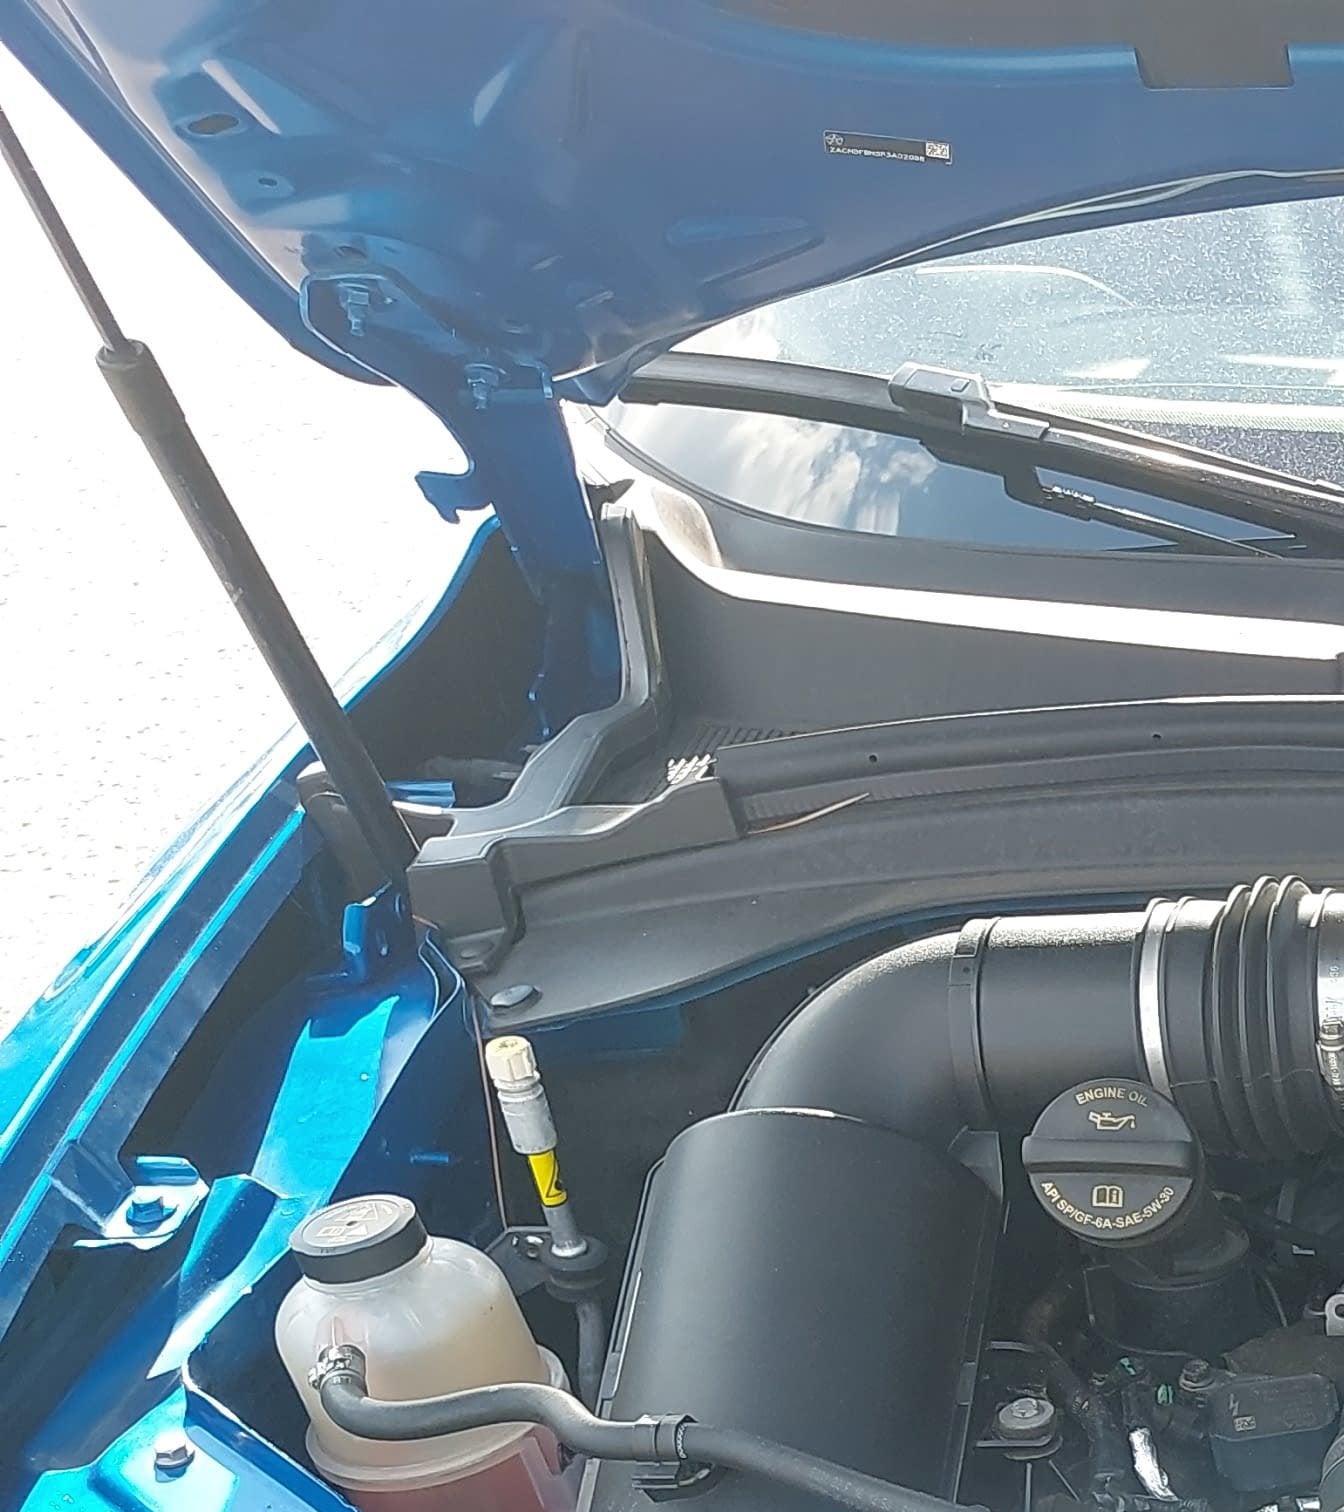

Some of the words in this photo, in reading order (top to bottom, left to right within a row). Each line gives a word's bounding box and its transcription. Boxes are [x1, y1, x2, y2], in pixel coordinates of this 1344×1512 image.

[1075, 1087, 1125, 1105] ENGINE
[1129, 1089, 1149, 1107] OIL
[1041, 1181, 1060, 1204] API
